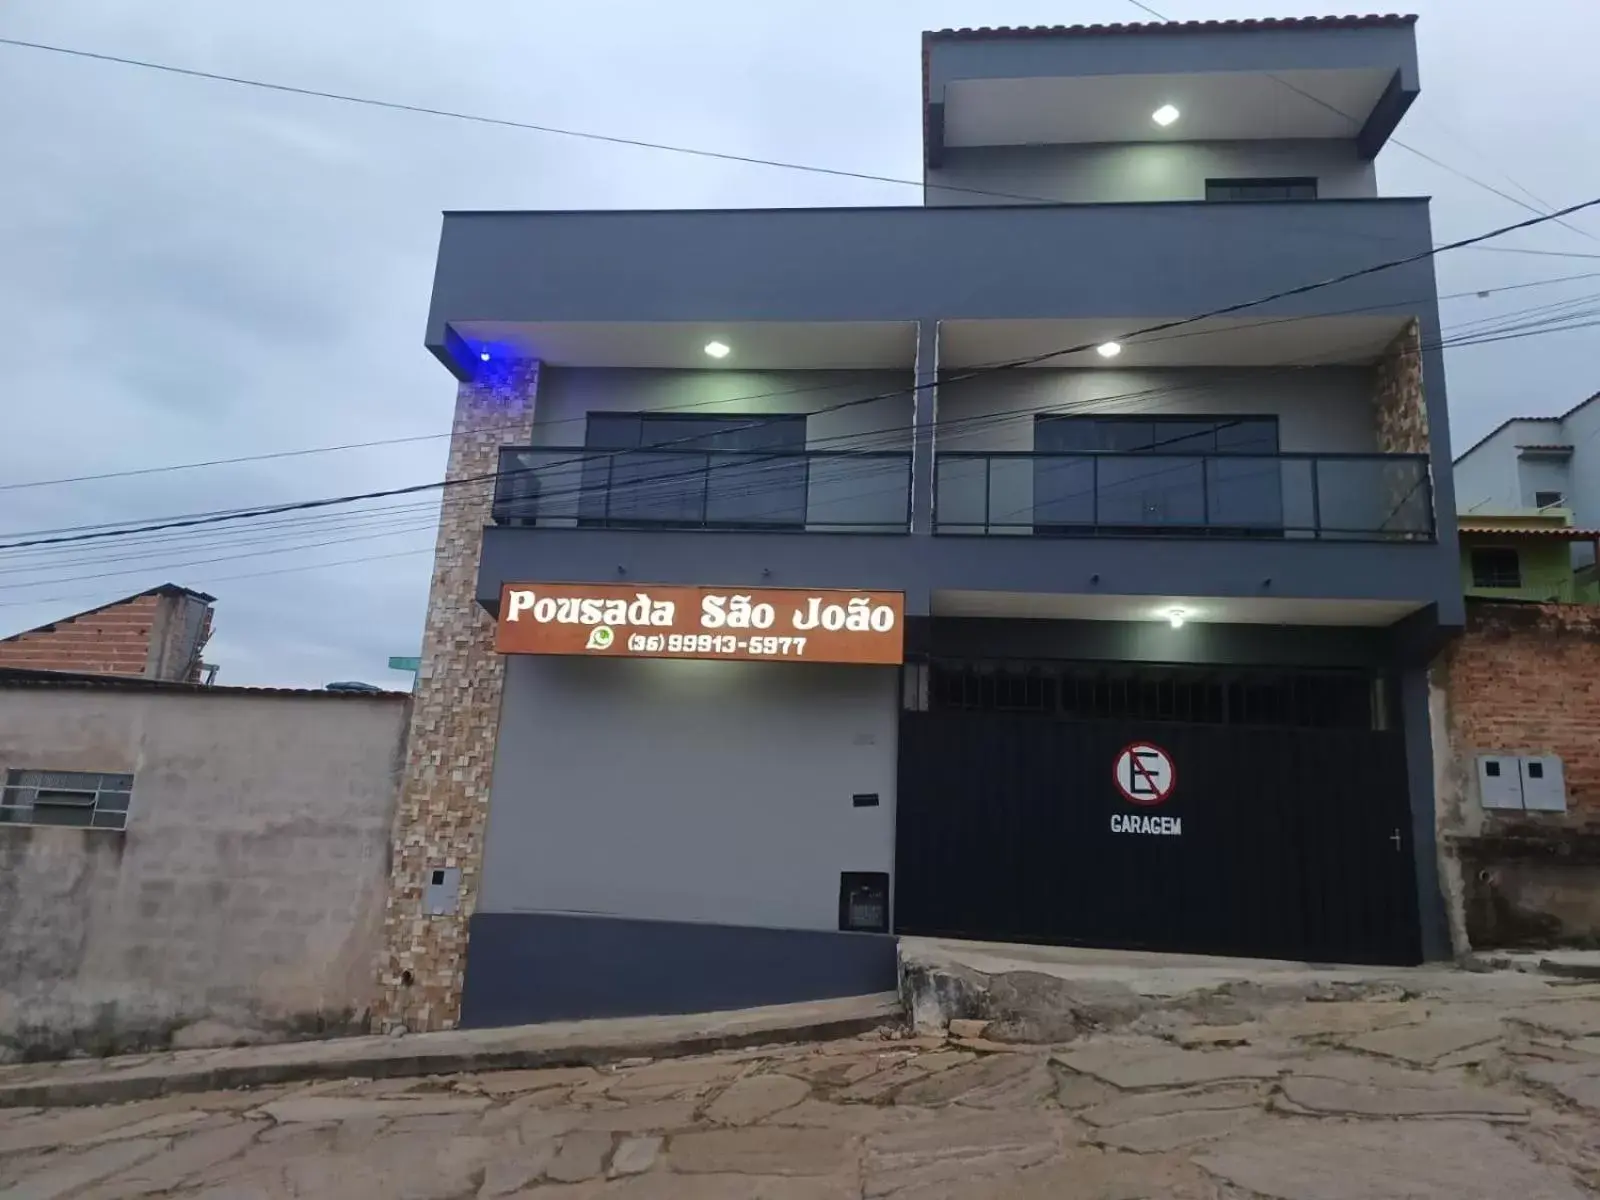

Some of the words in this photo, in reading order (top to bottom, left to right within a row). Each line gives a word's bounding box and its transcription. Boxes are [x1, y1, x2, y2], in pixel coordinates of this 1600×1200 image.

[506, 590, 676, 627] Pousada
[700, 594, 776, 631] São
[791, 595, 895, 633] João
[668, 634, 808, 656] 99913-5977
[1110, 814, 1182, 835] GARAGEM
